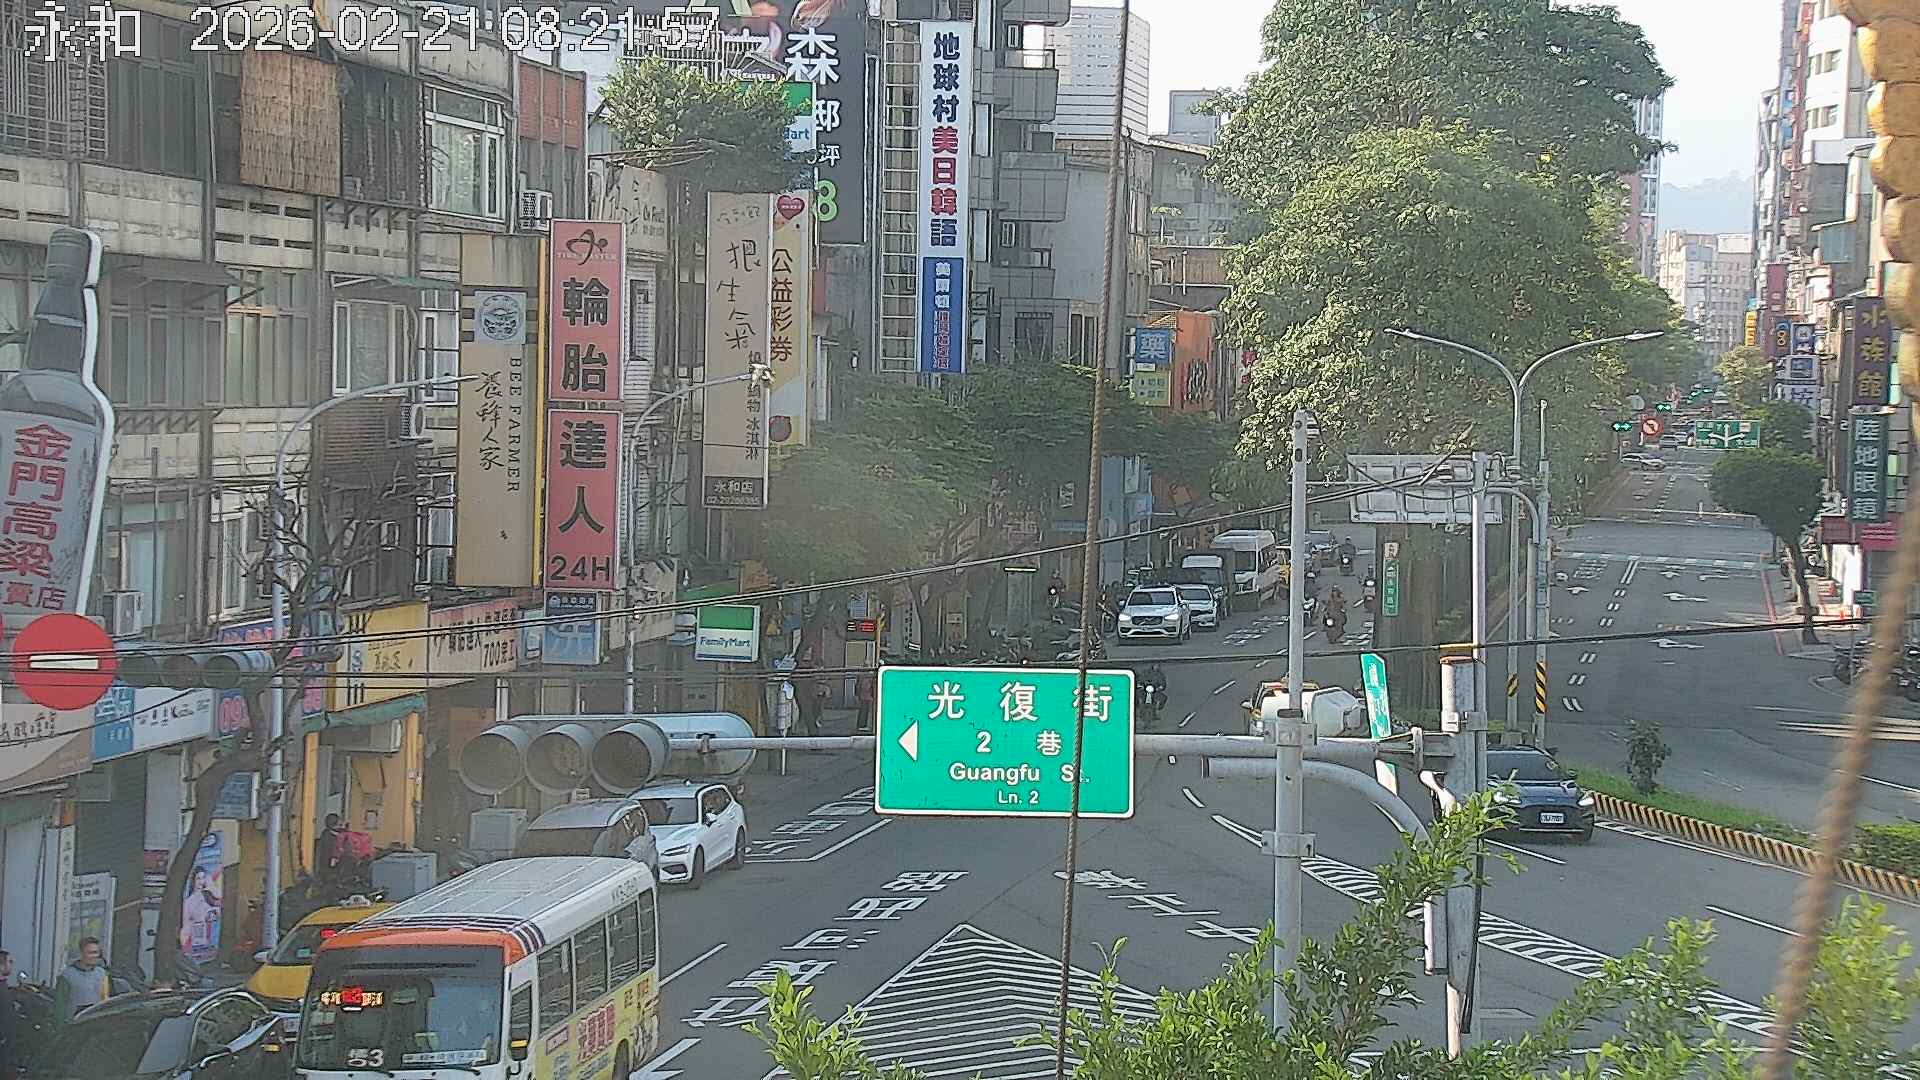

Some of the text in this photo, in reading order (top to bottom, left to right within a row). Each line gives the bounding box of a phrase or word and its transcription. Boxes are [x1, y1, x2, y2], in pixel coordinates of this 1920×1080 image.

[770, 248, 794, 362] 公益彩券
[507, 357, 522, 492] BEE FARMER
[549, 555, 613, 582] 24H
[927, 681, 1113, 722] 光復街
[949, 763, 1041, 785] Guangfu
[997, 790, 1040, 804] Ln. 2
